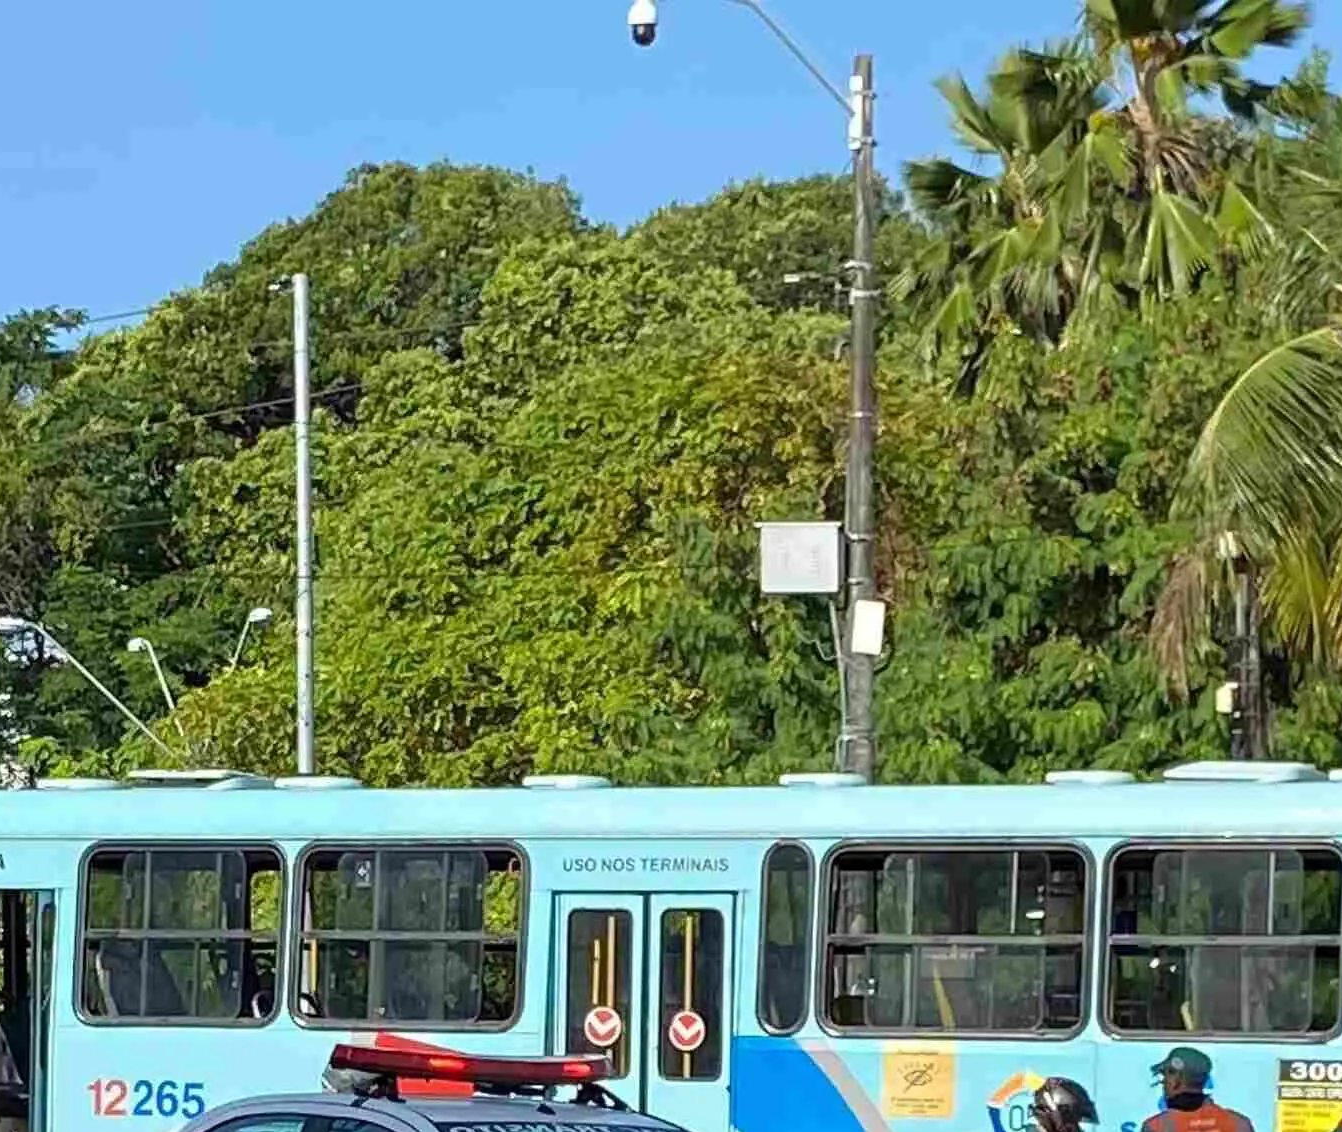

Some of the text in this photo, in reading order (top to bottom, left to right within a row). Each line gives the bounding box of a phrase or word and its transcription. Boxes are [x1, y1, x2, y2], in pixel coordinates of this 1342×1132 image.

[562, 857, 730, 872] USO NOS TERMINAIS
